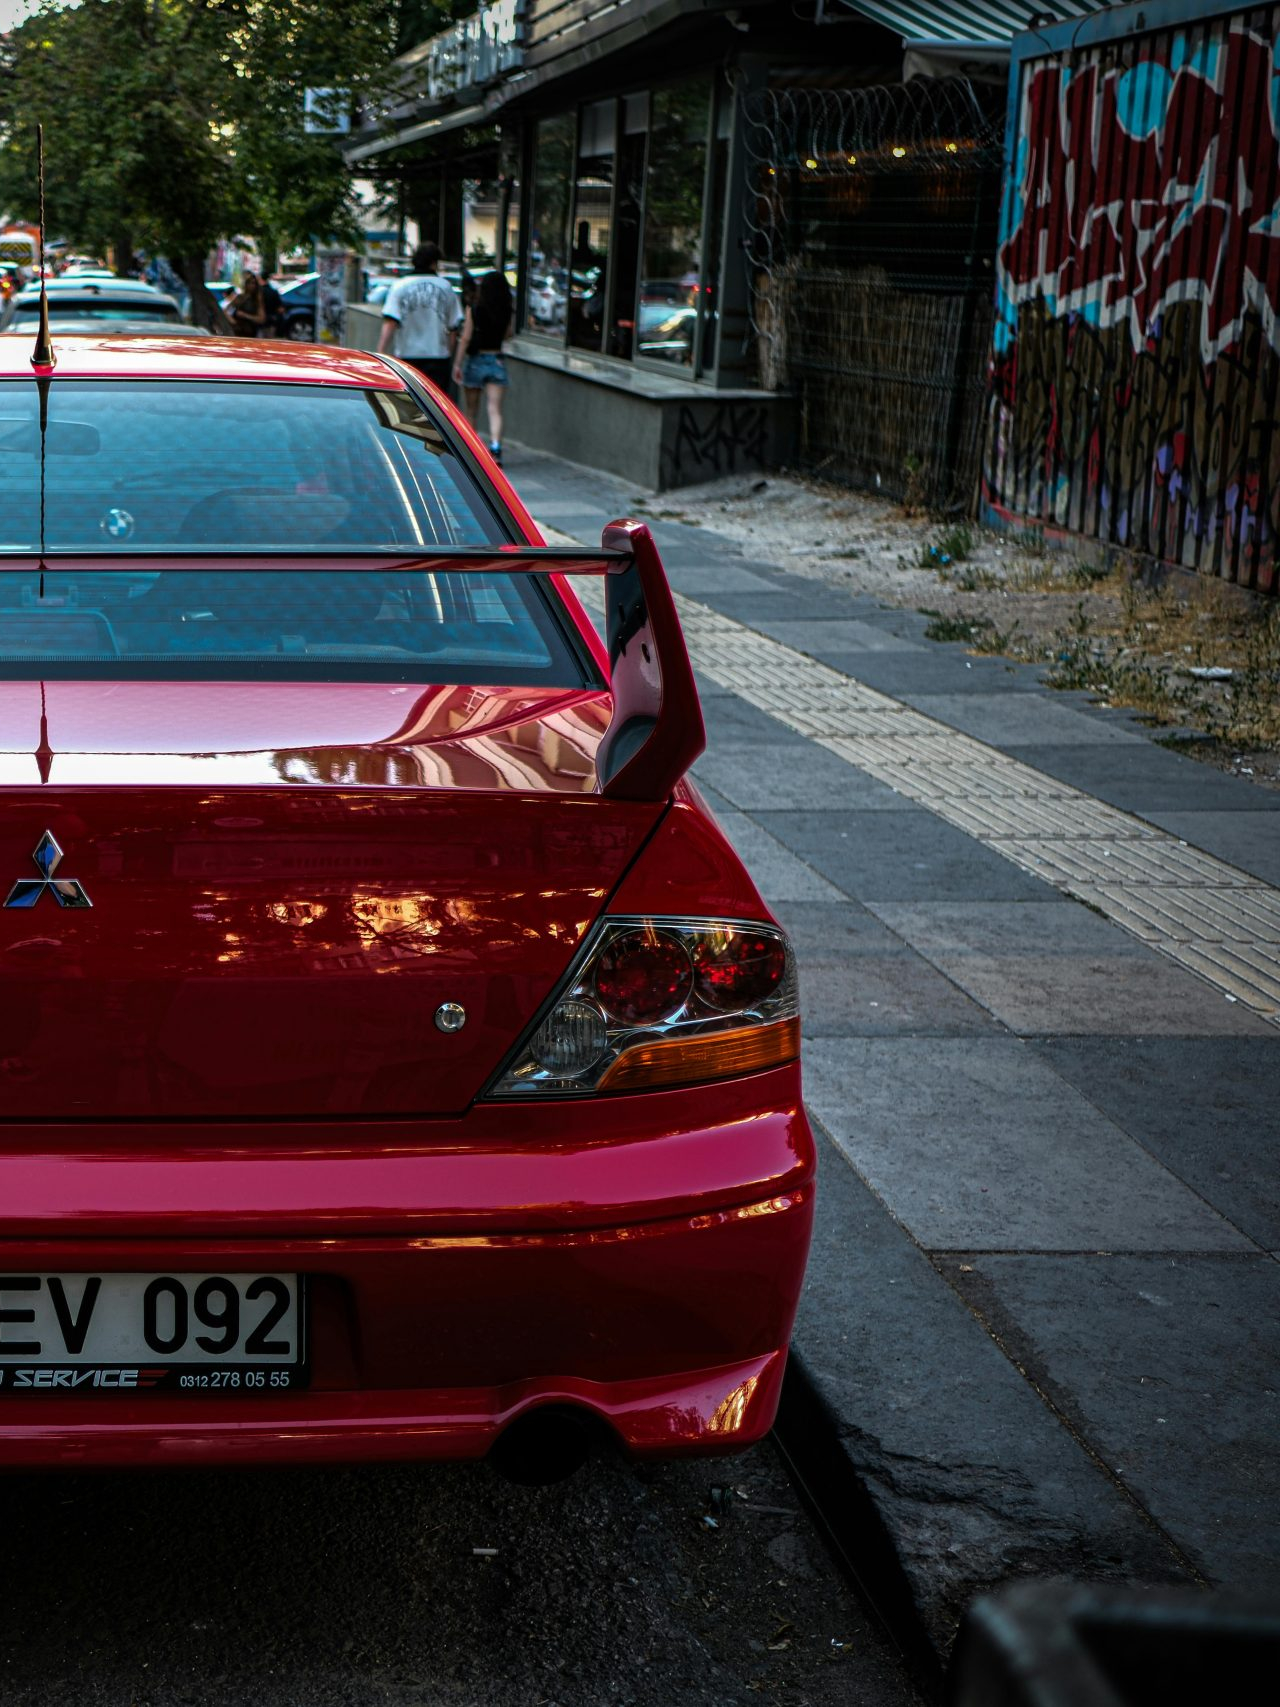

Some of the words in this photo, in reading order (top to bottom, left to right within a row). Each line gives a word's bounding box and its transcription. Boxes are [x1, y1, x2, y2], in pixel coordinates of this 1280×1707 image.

[143, 1276, 292, 1355] 092
[12, 1369, 139, 1387] SERVICE
[180, 1375, 208, 1388] 0312
[210, 1372, 240, 1387] 278
[245, 1372, 265, 1387] 05
[269, 1372, 290, 1387] 55
